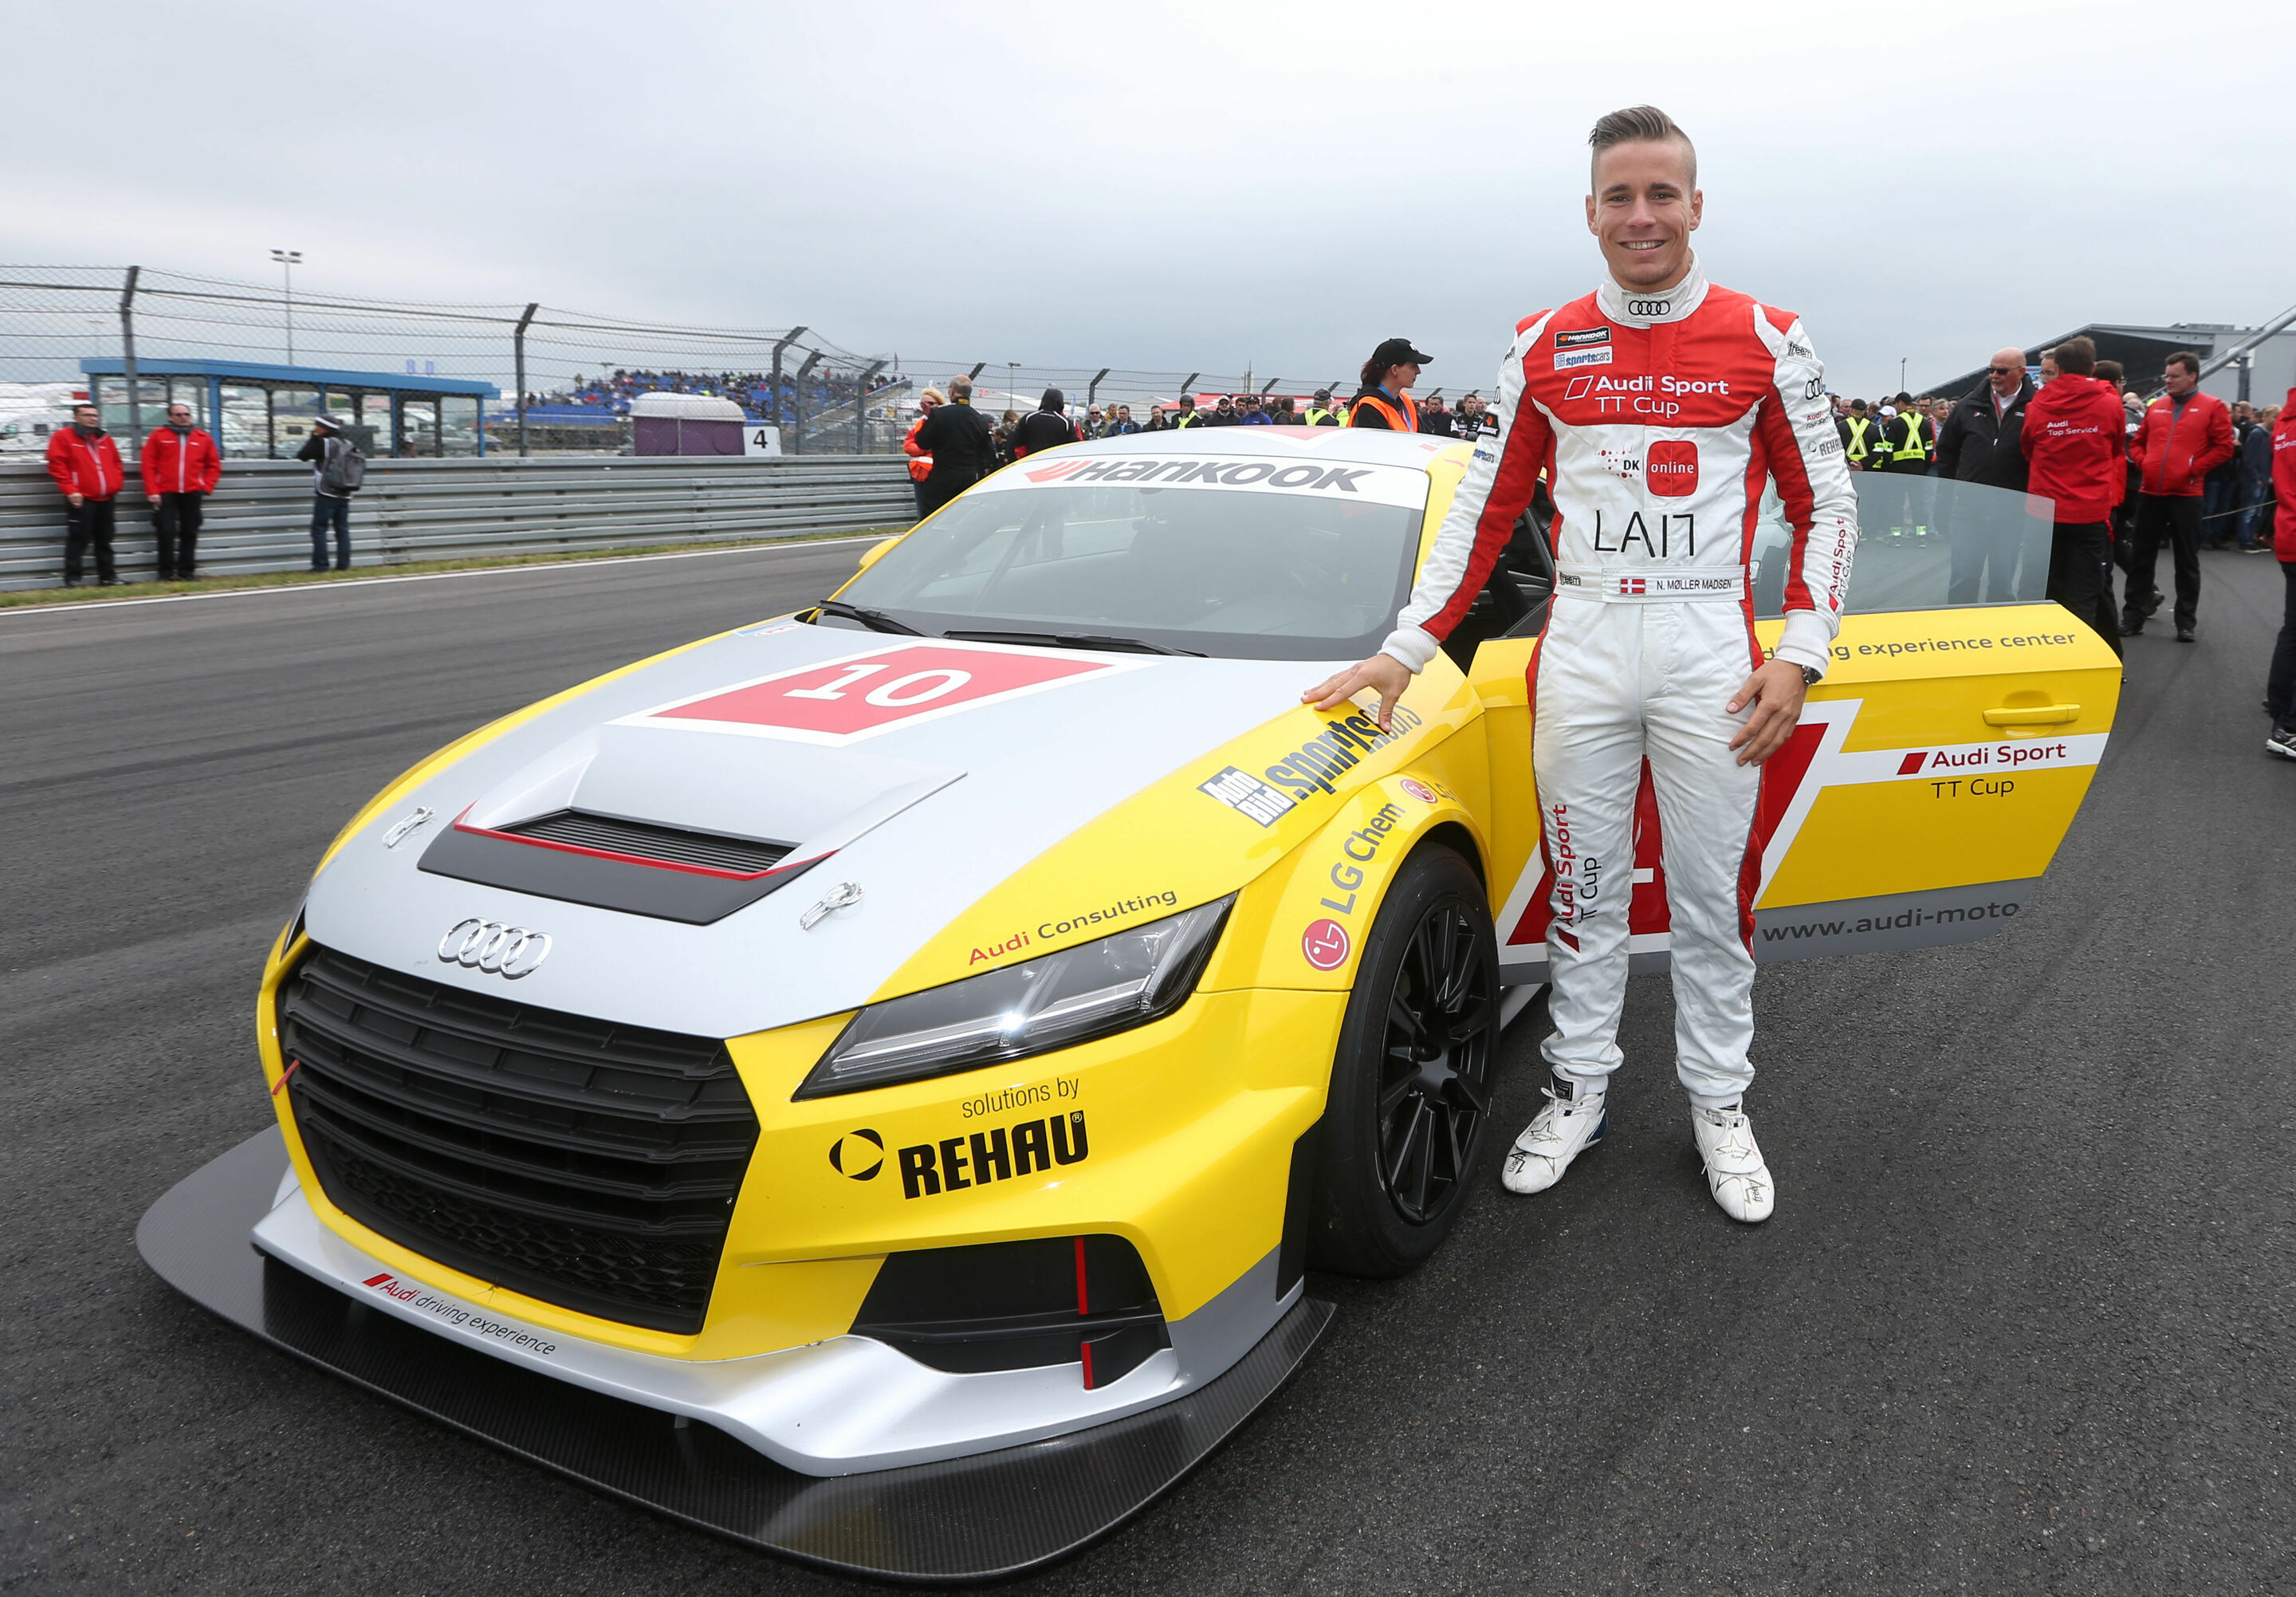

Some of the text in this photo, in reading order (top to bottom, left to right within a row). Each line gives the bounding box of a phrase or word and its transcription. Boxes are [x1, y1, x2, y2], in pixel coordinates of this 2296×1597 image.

[1595, 376, 1729, 396] Audi Sport
[1595, 396, 1681, 419] TT Cup
[753, 429, 768, 449] 4
[2046, 420, 2069, 429] Audi
[2066, 426, 2098, 435] Service
[1623, 459, 1641, 471] DK
[1650, 461, 1695, 474] online
[1830, 517, 1846, 593] Audi Spot
[1656, 578, 1732, 591] N. MØLLER MADSEN
[1858, 635, 1994, 658] experience
[1999, 631, 2076, 648] center
[782, 663, 973, 707] 10
[1930, 742, 2067, 769] Audi Sport
[1201, 770, 1263, 808] Auto
[1930, 777, 2015, 799] TT Cup
[1236, 785, 1295, 826] Bild
[1320, 862, 1364, 915] LG
[1343, 802, 1406, 862] Chem
[1553, 804, 1576, 926] Audi Sport
[1580, 856, 1602, 900] Cup
[968, 889, 1178, 966] Audi Consulting
[1762, 901, 2020, 942] www.audi-moto
[961, 1076, 1080, 1119] solutions by
[379, 1280, 556, 1356] Audi driving experience
